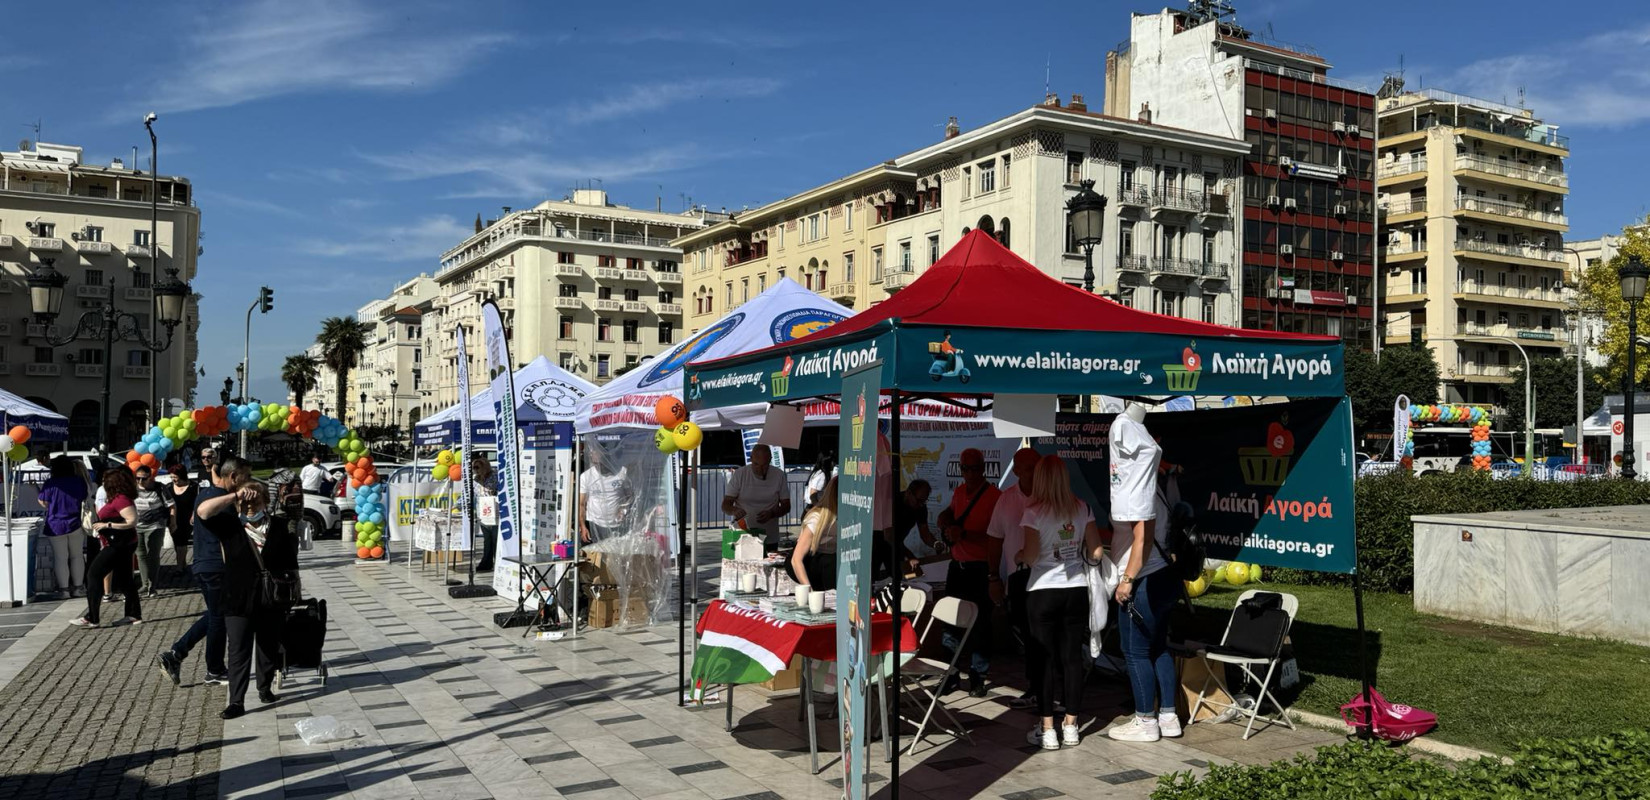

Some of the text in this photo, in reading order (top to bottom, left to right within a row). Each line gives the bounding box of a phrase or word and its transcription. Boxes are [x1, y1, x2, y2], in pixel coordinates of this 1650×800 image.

[795, 350, 832, 379] Λαϊκή
[974, 351, 1141, 374] www.elaikiagora.gr
[1212, 352, 1332, 381] Λαϊκή Αγορά
[1056, 421, 1110, 434] τήστε σήμερ
[1207, 492, 1333, 522] Λαϊκή Αγορά
